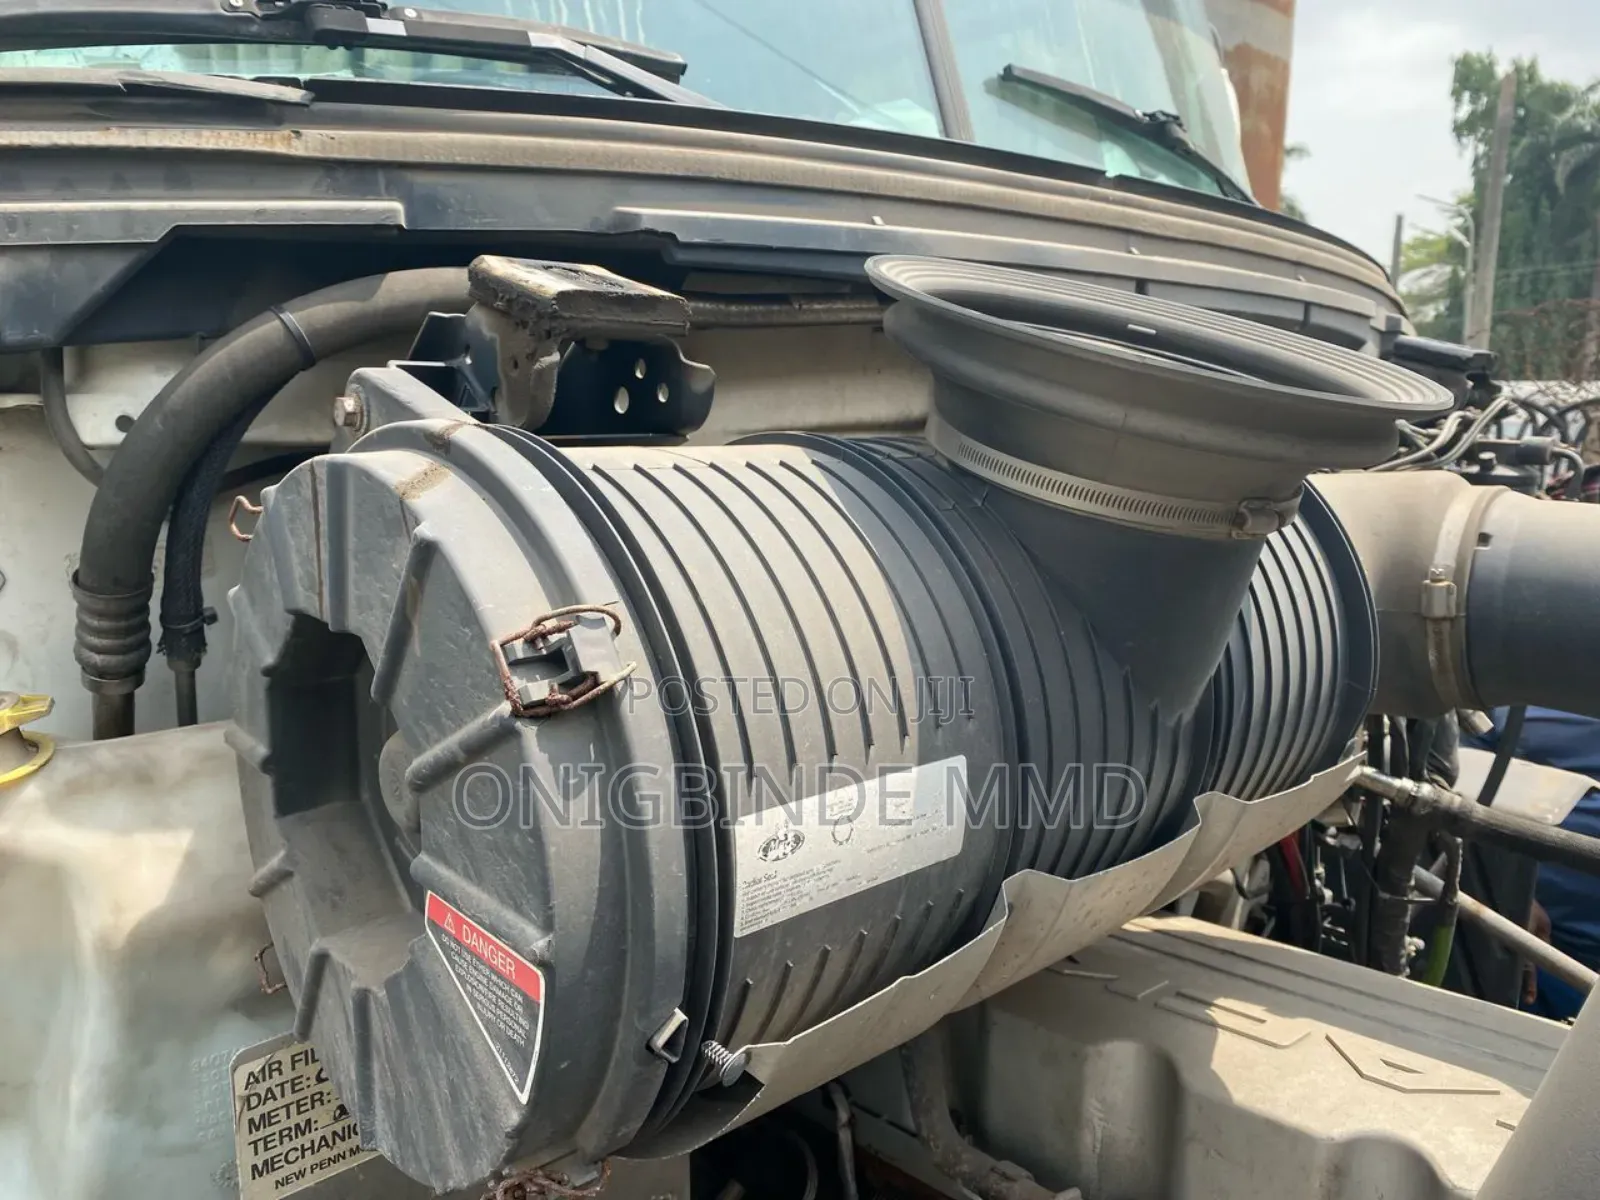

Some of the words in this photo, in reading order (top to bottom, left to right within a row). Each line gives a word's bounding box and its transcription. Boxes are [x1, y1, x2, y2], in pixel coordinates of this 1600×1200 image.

[441, 932, 449, 945] DO
[450, 939, 460, 955] NOT
[462, 948, 470, 963] USE
[491, 971, 509, 993] WHICH
[510, 986, 522, 1004] CAN
[463, 924, 515, 979] DANGER
[450, 950, 467, 970] CAUSE
[469, 964, 488, 986] ENGINE
[489, 980, 512, 1006] DAMAGE
[513, 1000, 522, 1014] OR
[466, 982, 470, 993] IN
[472, 987, 495, 1013] SERIOUS
[496, 1007, 526, 1039] PERSONAL
[496, 1017, 505, 1032] OR
[506, 1025, 524, 1048] DEATH
[498, 998, 529, 1030] RESULTING
[244, 1060, 283, 1091] AIR
[246, 1074, 311, 1111] DATE:
[248, 1090, 332, 1135] METER:
[248, 1118, 319, 1156] TERM:
[275, 1168, 306, 1190] NEW
[310, 1151, 346, 1174] PENN
[350, 1145, 365, 1157] M
